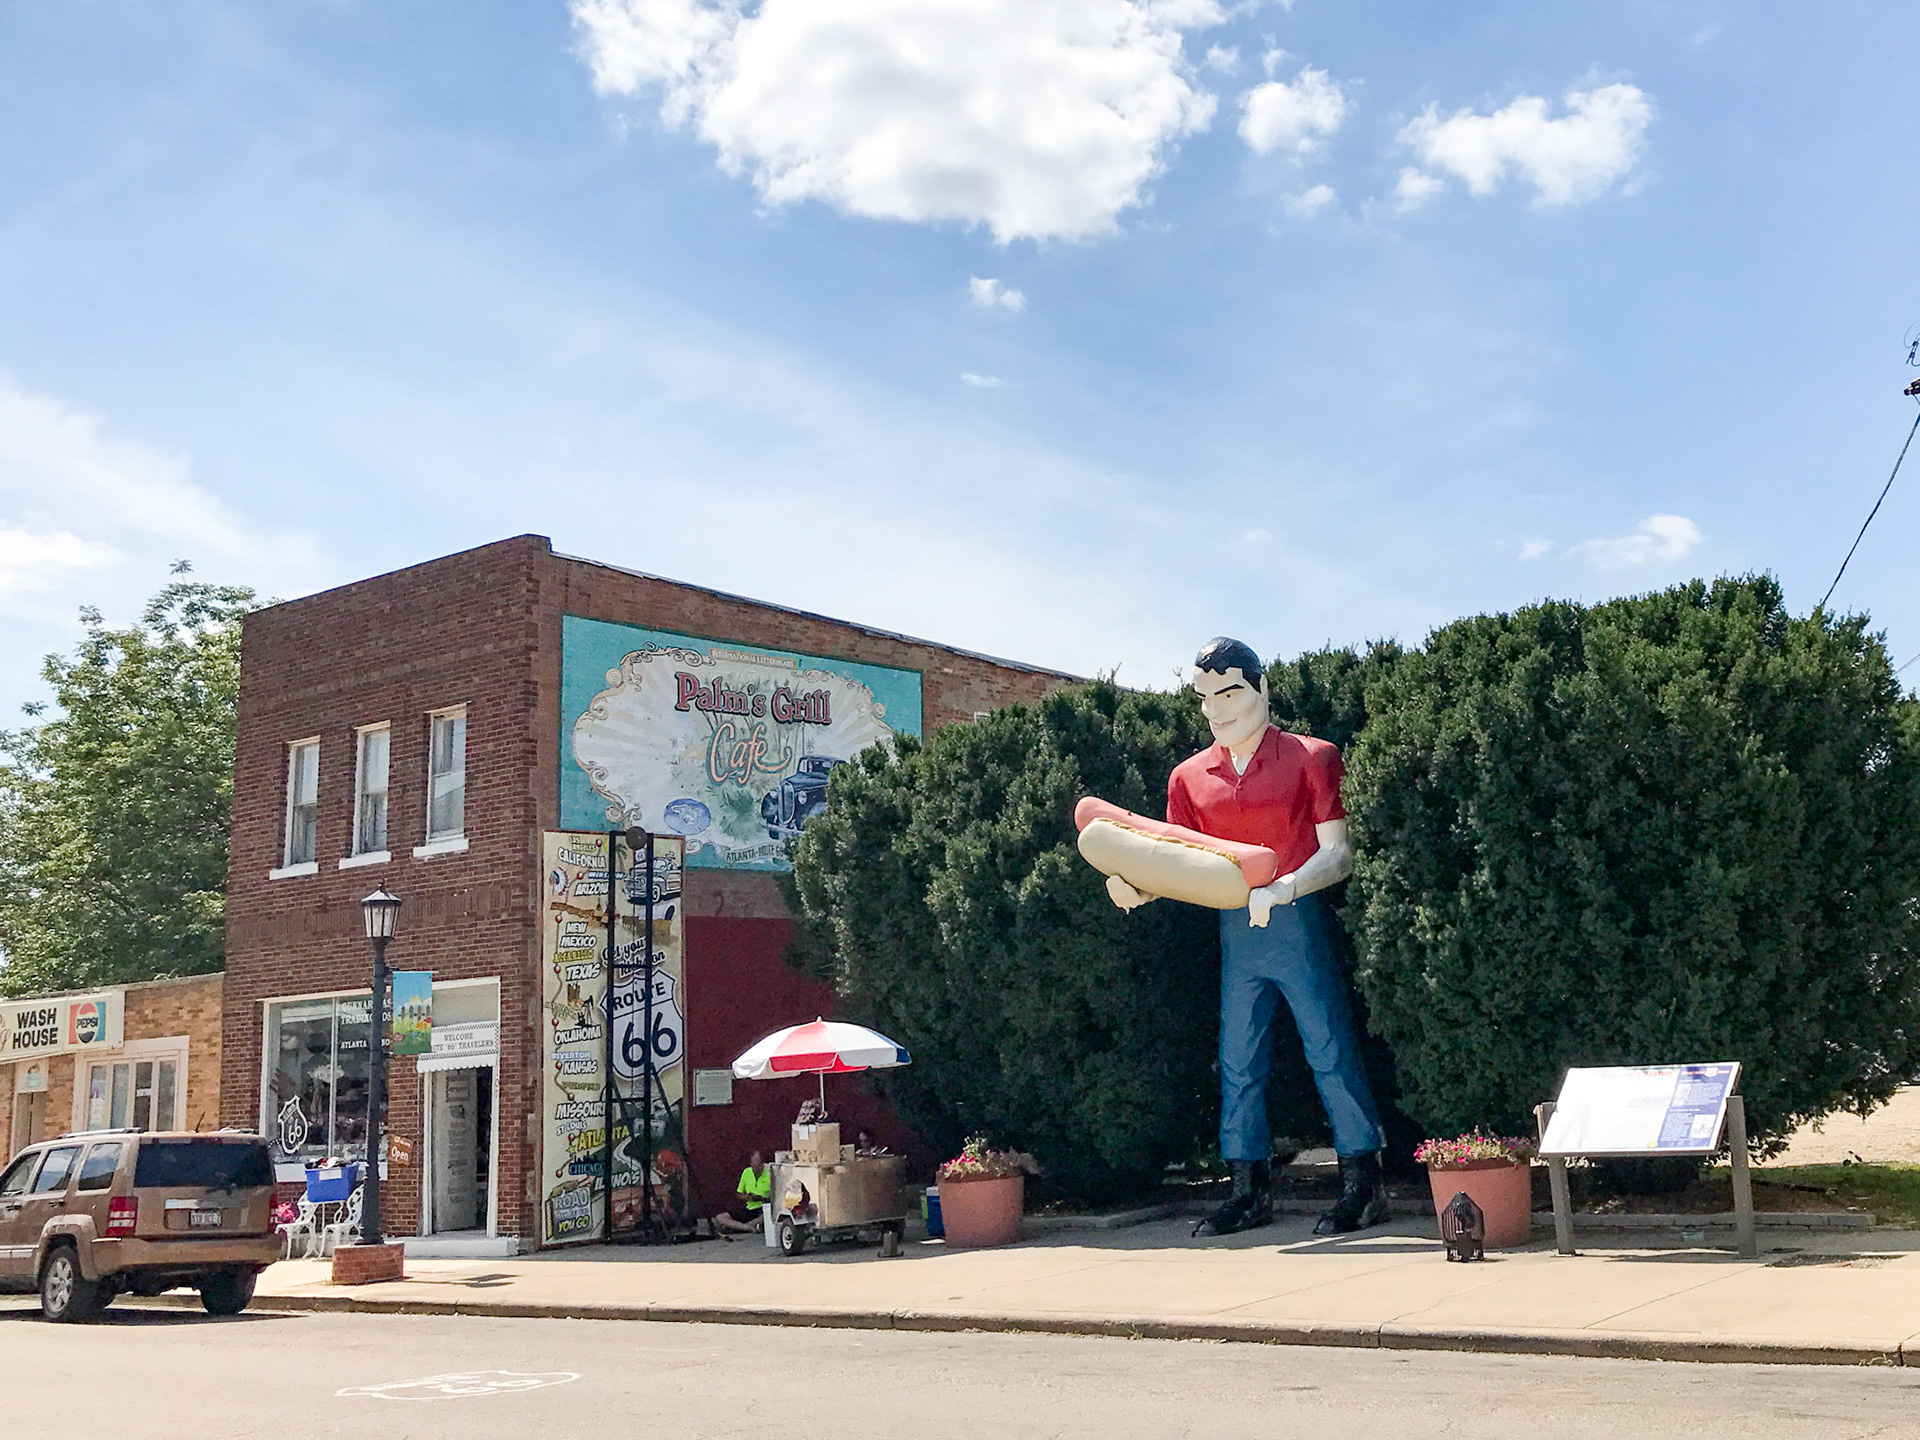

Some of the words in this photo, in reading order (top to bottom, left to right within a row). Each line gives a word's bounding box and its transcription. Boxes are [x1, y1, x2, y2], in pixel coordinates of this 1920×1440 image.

[675, 672, 766, 717] Palm's
[771, 688, 832, 725] Grill
[558, 847, 606, 869] CALIFORNIA
[575, 881, 609, 896] ARIZON
[566, 921, 588, 934] NEW
[560, 935, 596, 948] MEXICO
[566, 963, 601, 981] TEXAS
[17, 1007, 57, 1029] WASH
[76, 1017, 98, 1029] PEPSI
[12, 1027, 58, 1049] HOUSE
[444, 1032, 473, 1042] WELCOME
[555, 1025, 602, 1045] OKLAHOMA
[622, 1012, 677, 1068] 66
[340, 1040, 367, 1049] ATLANTA
[563, 1060, 598, 1075] KANSAS
[555, 1101, 606, 1119] MISSOURI
[288, 1118, 302, 1144] 66
[556, 1124, 565, 1136] ST
[566, 1120, 587, 1131] LOUIS
[391, 1146, 408, 1161] Open
[555, 1189, 589, 1209] ROAD
[558, 1220, 575, 1232] YOU
[576, 1216, 590, 1229] GO
